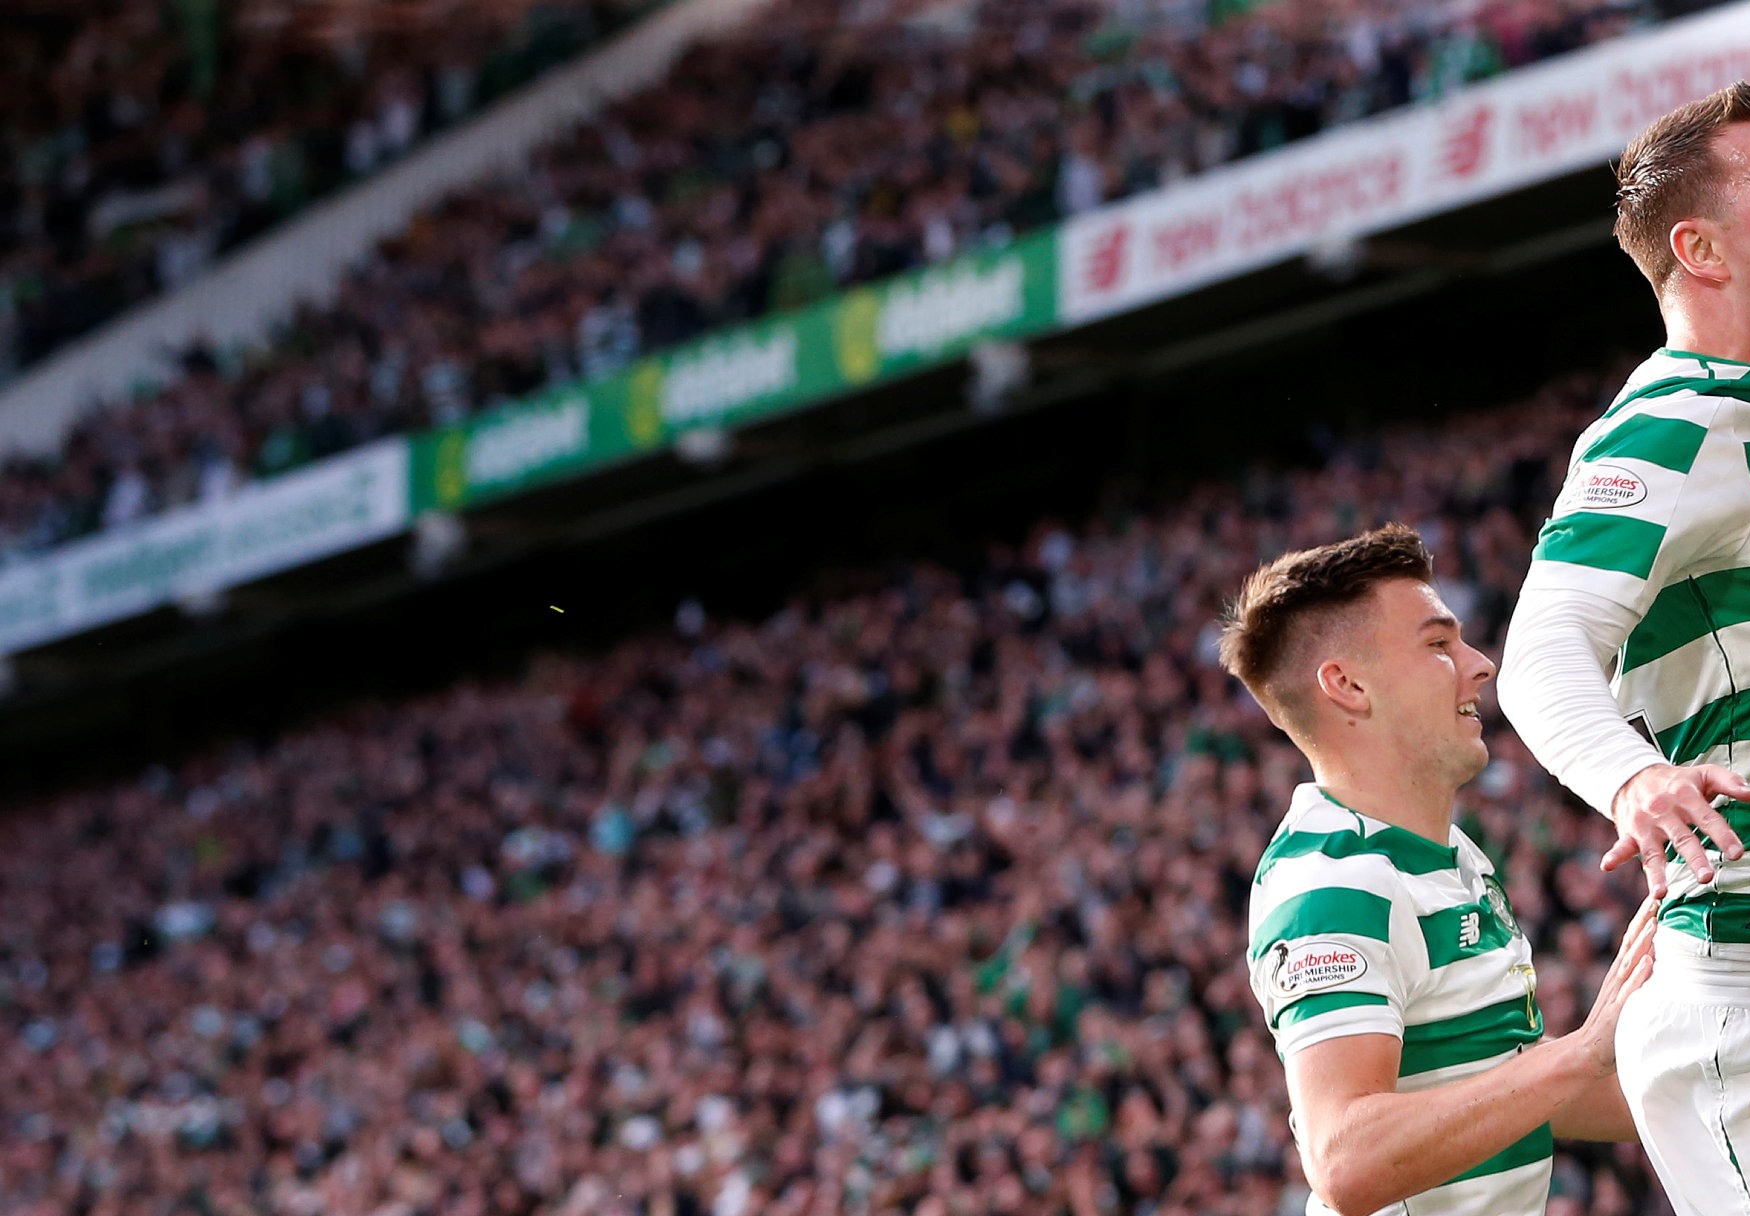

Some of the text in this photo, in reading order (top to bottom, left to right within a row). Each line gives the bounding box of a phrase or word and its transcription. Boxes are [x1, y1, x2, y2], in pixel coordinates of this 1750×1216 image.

[1578, 475, 1639, 491] brokes
[1287, 951, 1357, 974] Ladbrokes
[1301, 974, 1345, 986] HAMPIONS
